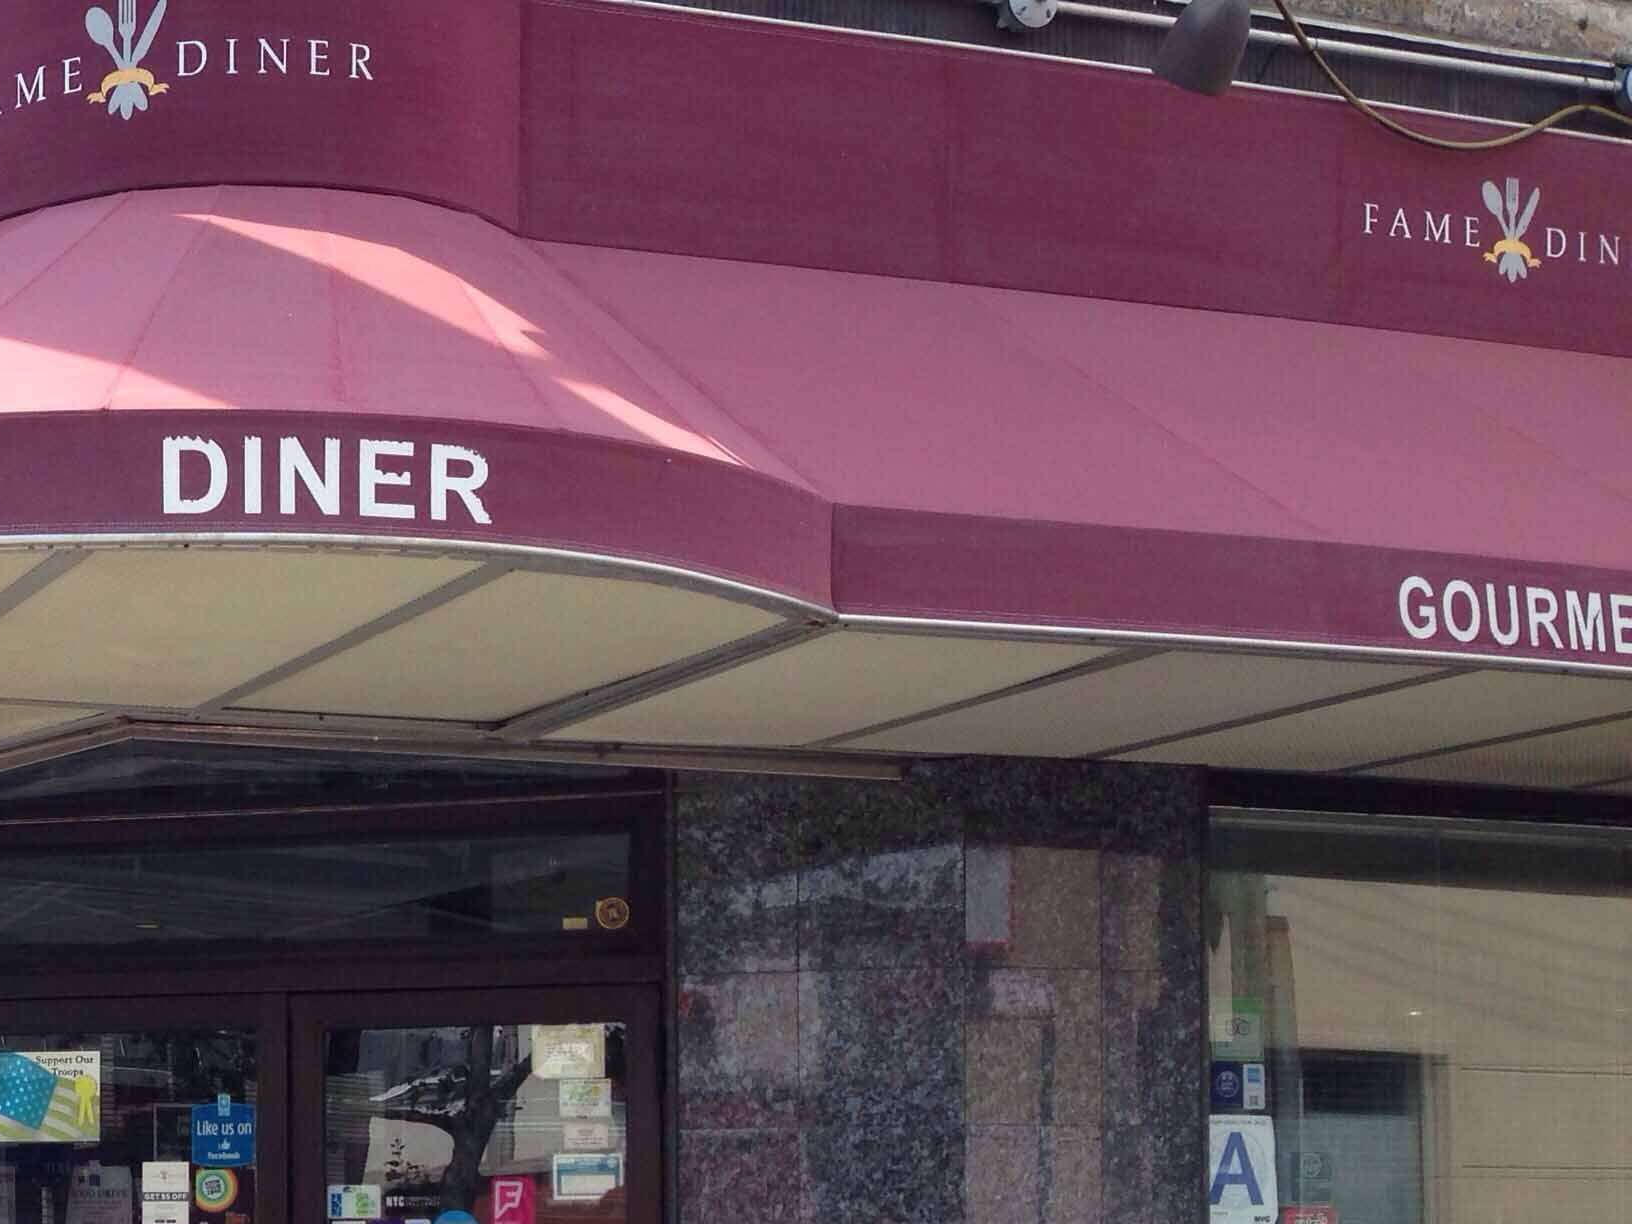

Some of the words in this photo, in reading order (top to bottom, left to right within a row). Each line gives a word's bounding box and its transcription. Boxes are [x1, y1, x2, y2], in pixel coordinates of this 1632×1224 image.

[177, 38, 374, 81] DINER
[1363, 202, 1480, 248] FAME
[162, 434, 493, 525] DINER
[36, 1056, 72, 1067] Support
[75, 1056, 94, 1065] Our
[52, 1068, 84, 1078] Troops
[196, 1120, 218, 1136] Like
[221, 1123, 235, 1135] us
[238, 1122, 253, 1135] on
[1209, 1131, 1265, 1206] A
